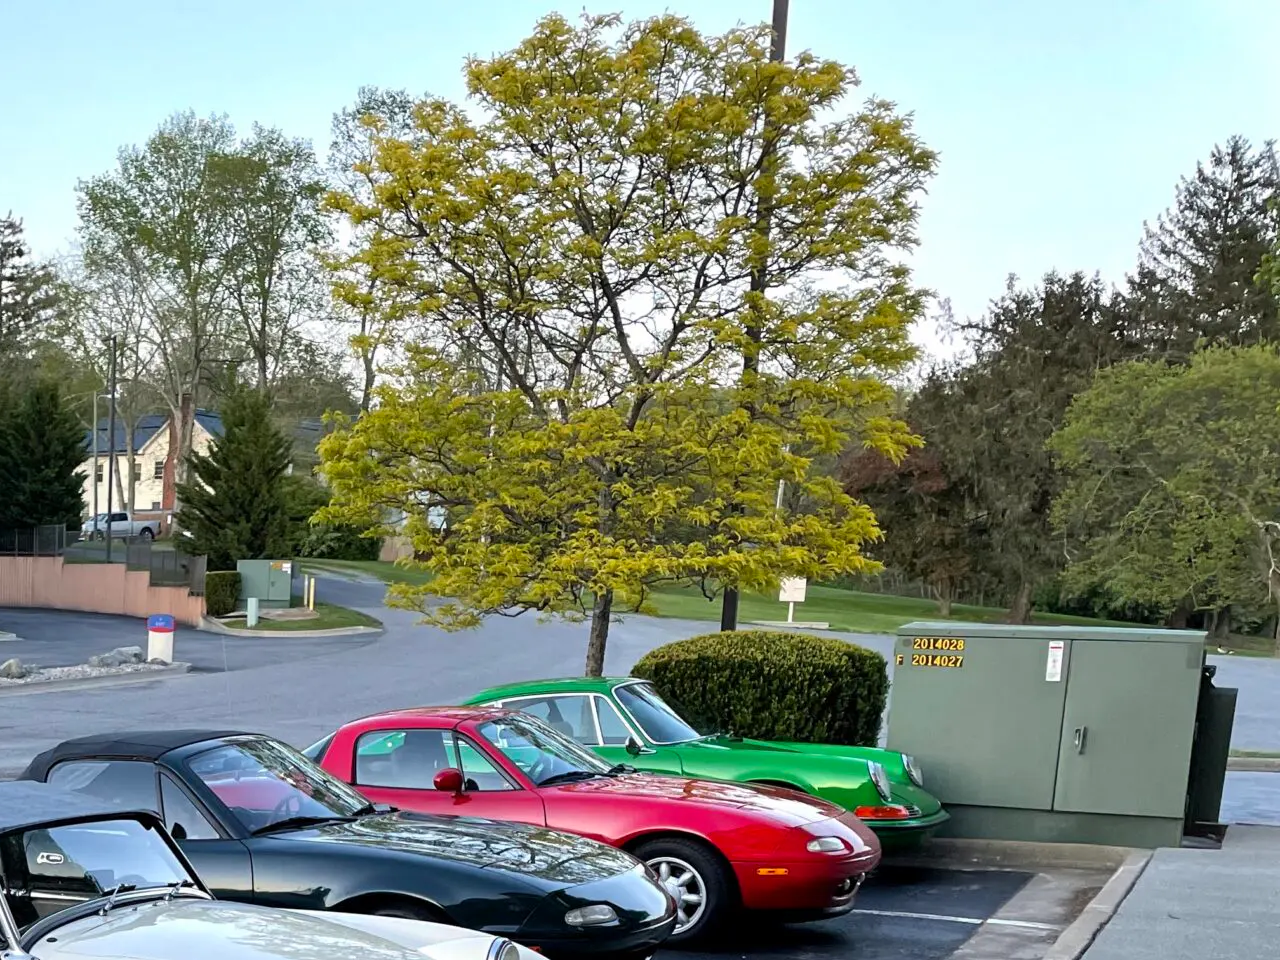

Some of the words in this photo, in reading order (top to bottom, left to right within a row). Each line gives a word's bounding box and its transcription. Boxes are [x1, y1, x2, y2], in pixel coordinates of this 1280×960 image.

[913, 638, 964, 650] 2014028
[896, 654, 904, 665] F
[912, 654, 963, 667] 2014027
